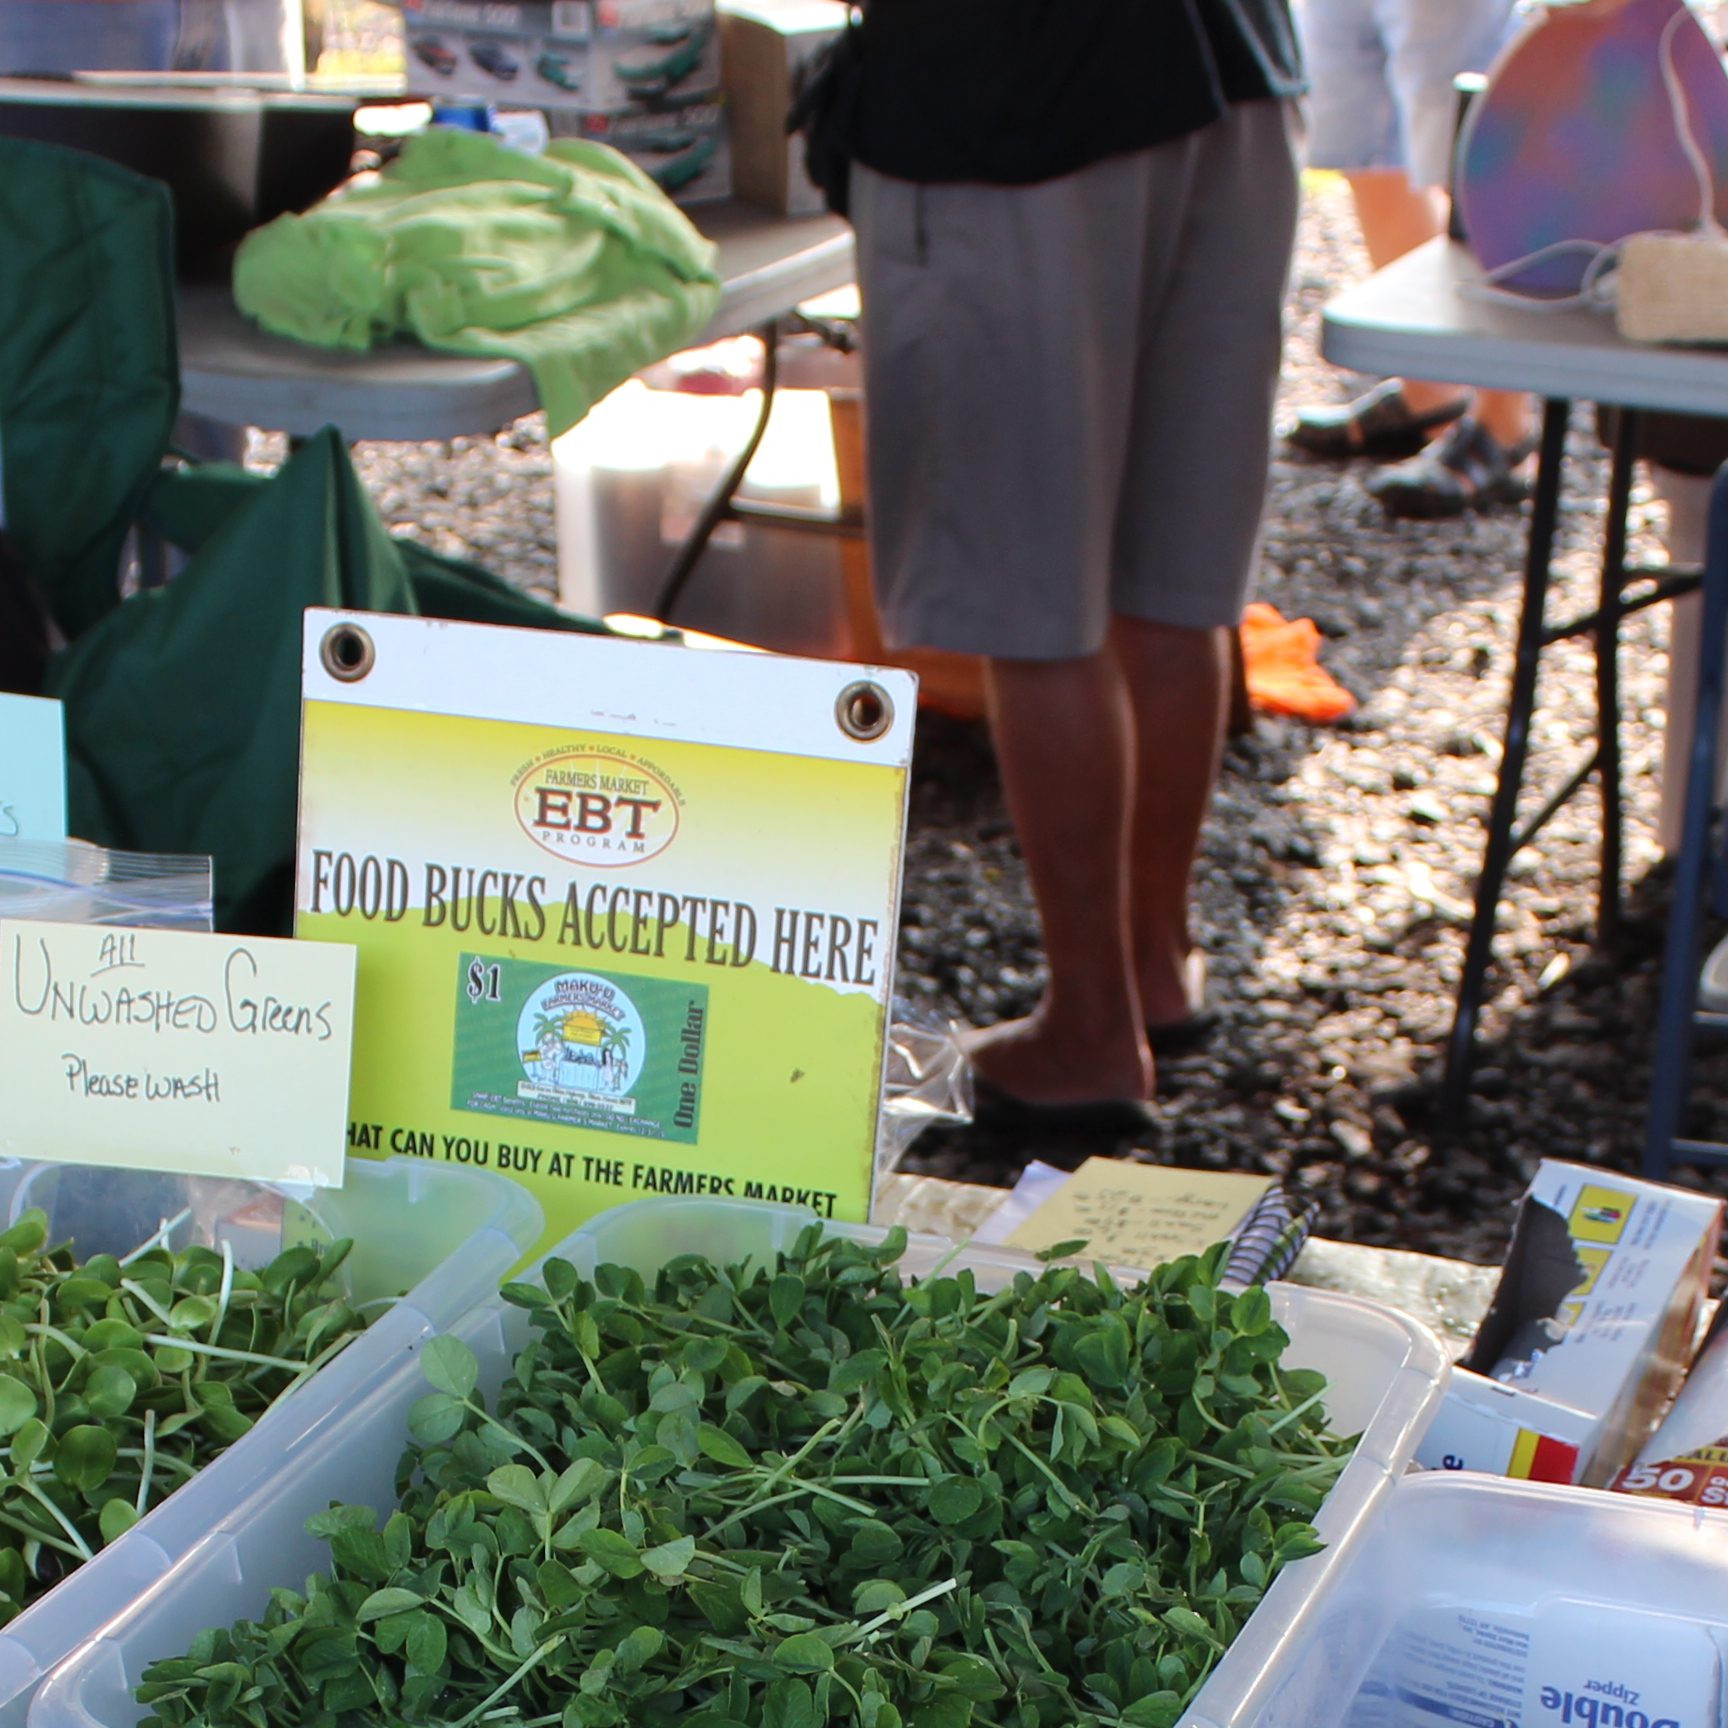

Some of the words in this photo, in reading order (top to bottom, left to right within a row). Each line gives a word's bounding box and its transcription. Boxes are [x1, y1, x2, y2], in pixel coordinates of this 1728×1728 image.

[541, 744, 587, 760] HEALTHY
[595, 744, 628, 759] LOCAL
[635, 756, 687, 807] AFFORDABLE
[544, 768, 598, 788] FARMERS
[599, 773, 650, 796] MARKET
[532, 786, 662, 840] EBT
[541, 829, 647, 853] PROGRAM
[309, 848, 410, 923] FOOD
[422, 862, 547, 942] BUCKS
[557, 879, 758, 969] ACCEPTED
[769, 906, 880, 987] HERE
[15, 933, 218, 1034] UNWASHED
[224, 948, 333, 1041] Greens
[466, 955, 502, 1004] $1
[678, 1000, 704, 1076] Dollar
[673, 1080, 697, 1129] One
[347, 1121, 383, 1150] HAT
[389, 1128, 435, 1159] CAN
[442, 1134, 489, 1166] YOU
[496, 1143, 542, 1173] BUY
[547, 1151, 575, 1178] AT
[582, 1156, 625, 1187] THE
[631, 1163, 736, 1196] FARMERS
[1622, 1465, 1696, 1492] 50
[1582, 1679, 1640, 1706] Zipper
